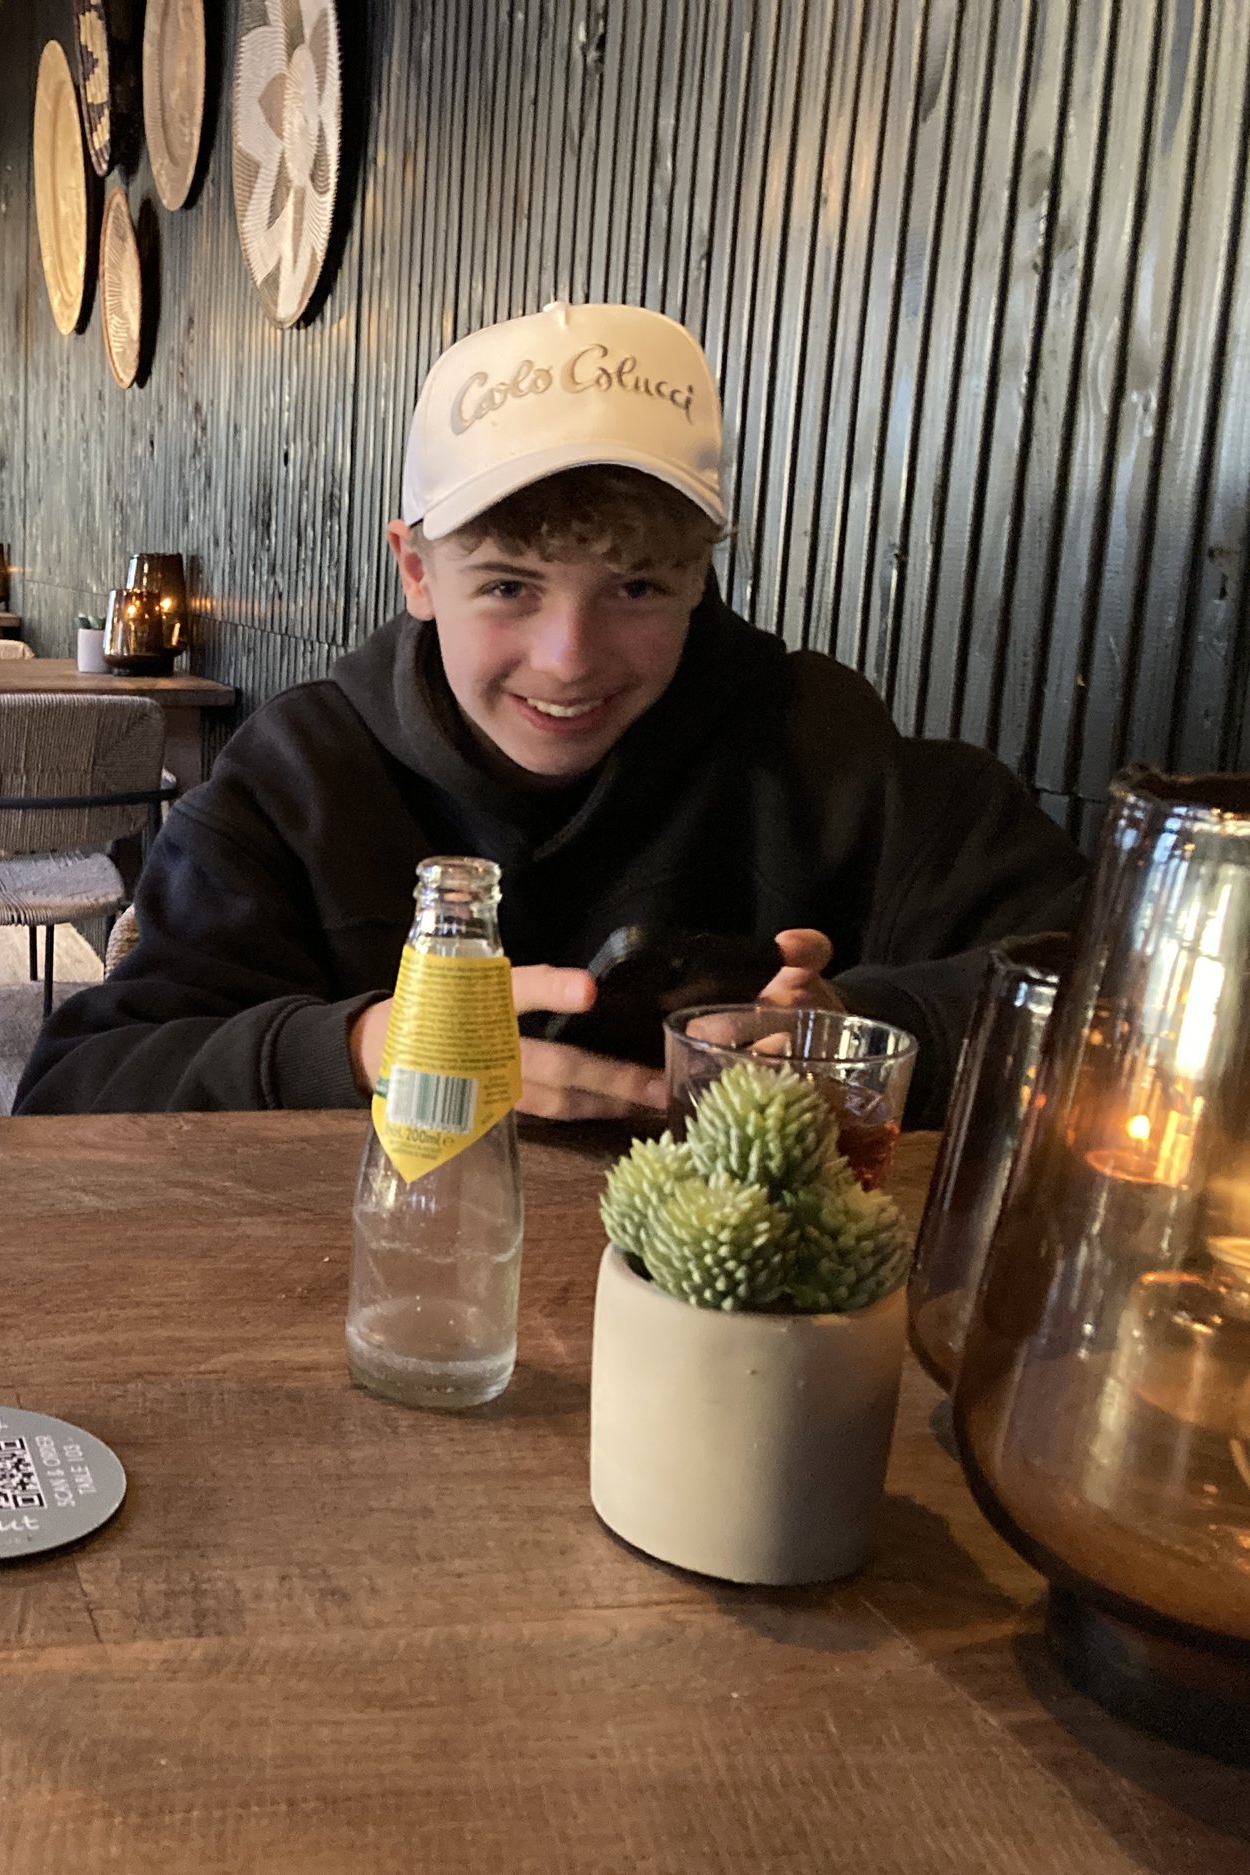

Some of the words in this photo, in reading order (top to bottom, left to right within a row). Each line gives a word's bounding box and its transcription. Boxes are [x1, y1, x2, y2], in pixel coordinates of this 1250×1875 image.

[561, 343, 695, 424] Colucci
[35, 1435, 61, 1467] ORDER
[50, 1479, 76, 1507] SCAN
[71, 1465, 97, 1495] TABLE
